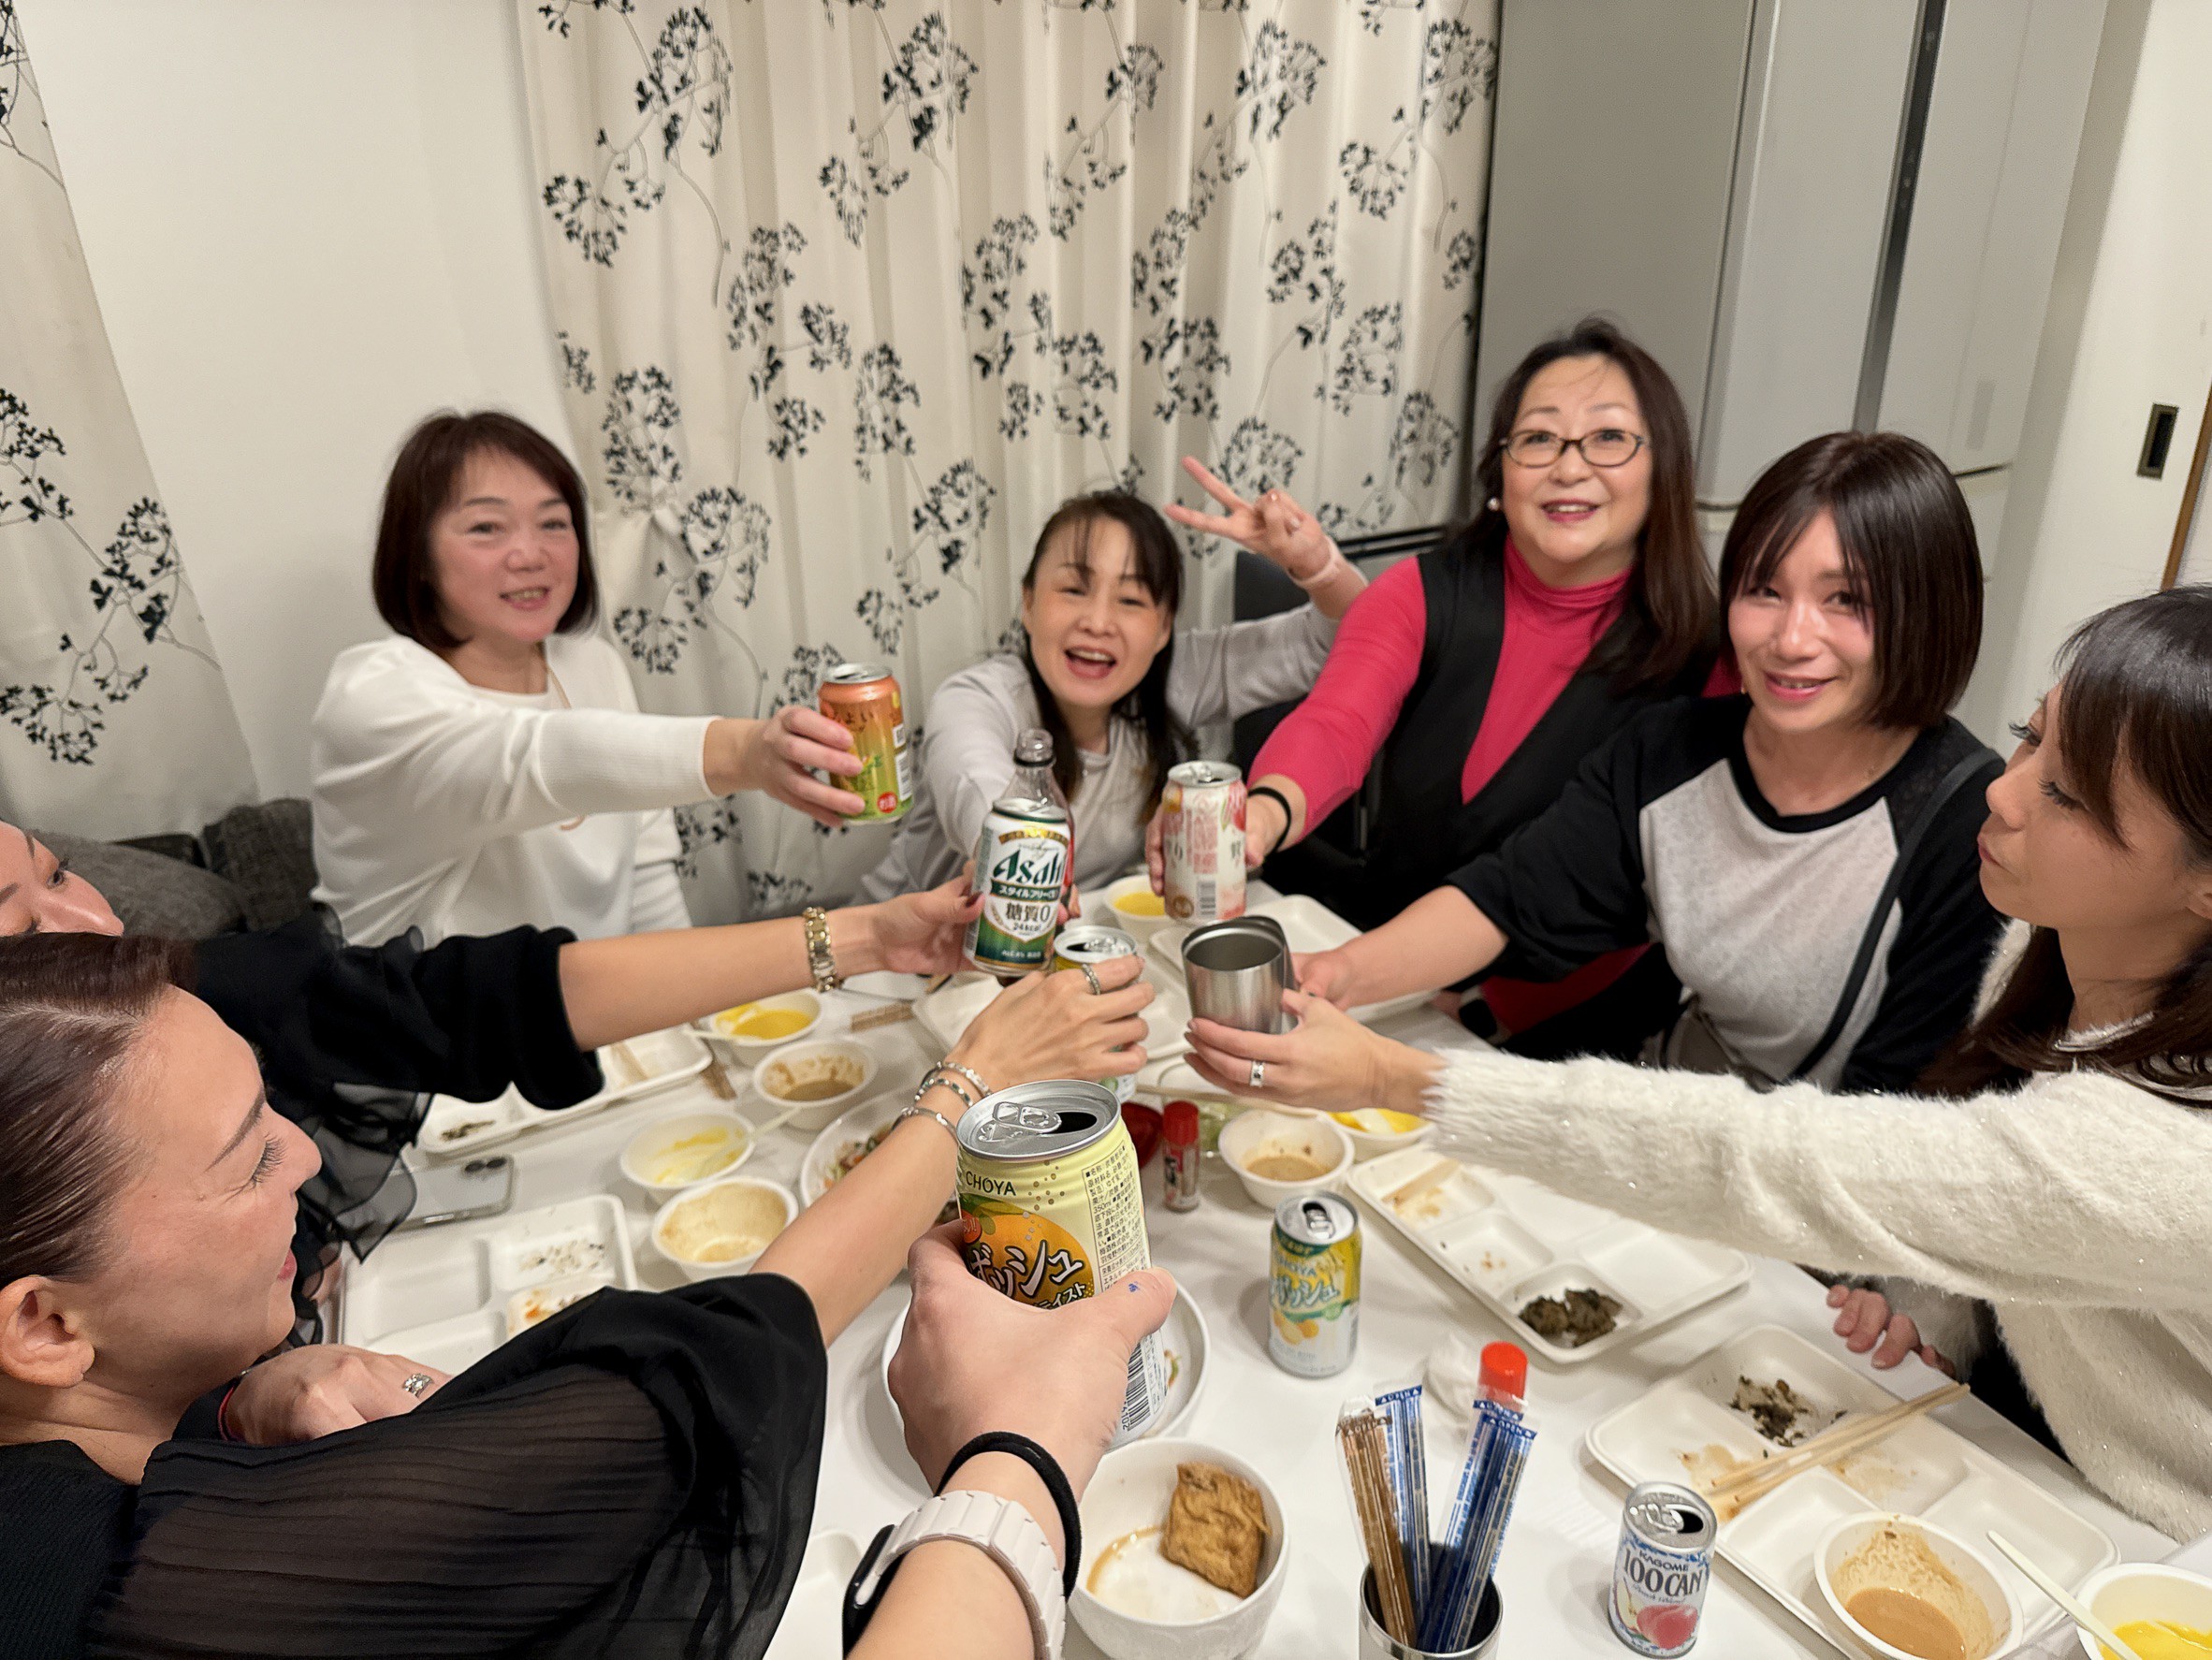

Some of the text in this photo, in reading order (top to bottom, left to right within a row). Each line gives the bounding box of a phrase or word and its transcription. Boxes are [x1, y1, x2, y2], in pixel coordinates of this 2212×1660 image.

[1006, 902, 1051, 922] 糖質0
[966, 1171, 1016, 1197] CHOYA
[1638, 1550, 1689, 1572] KAGOME
